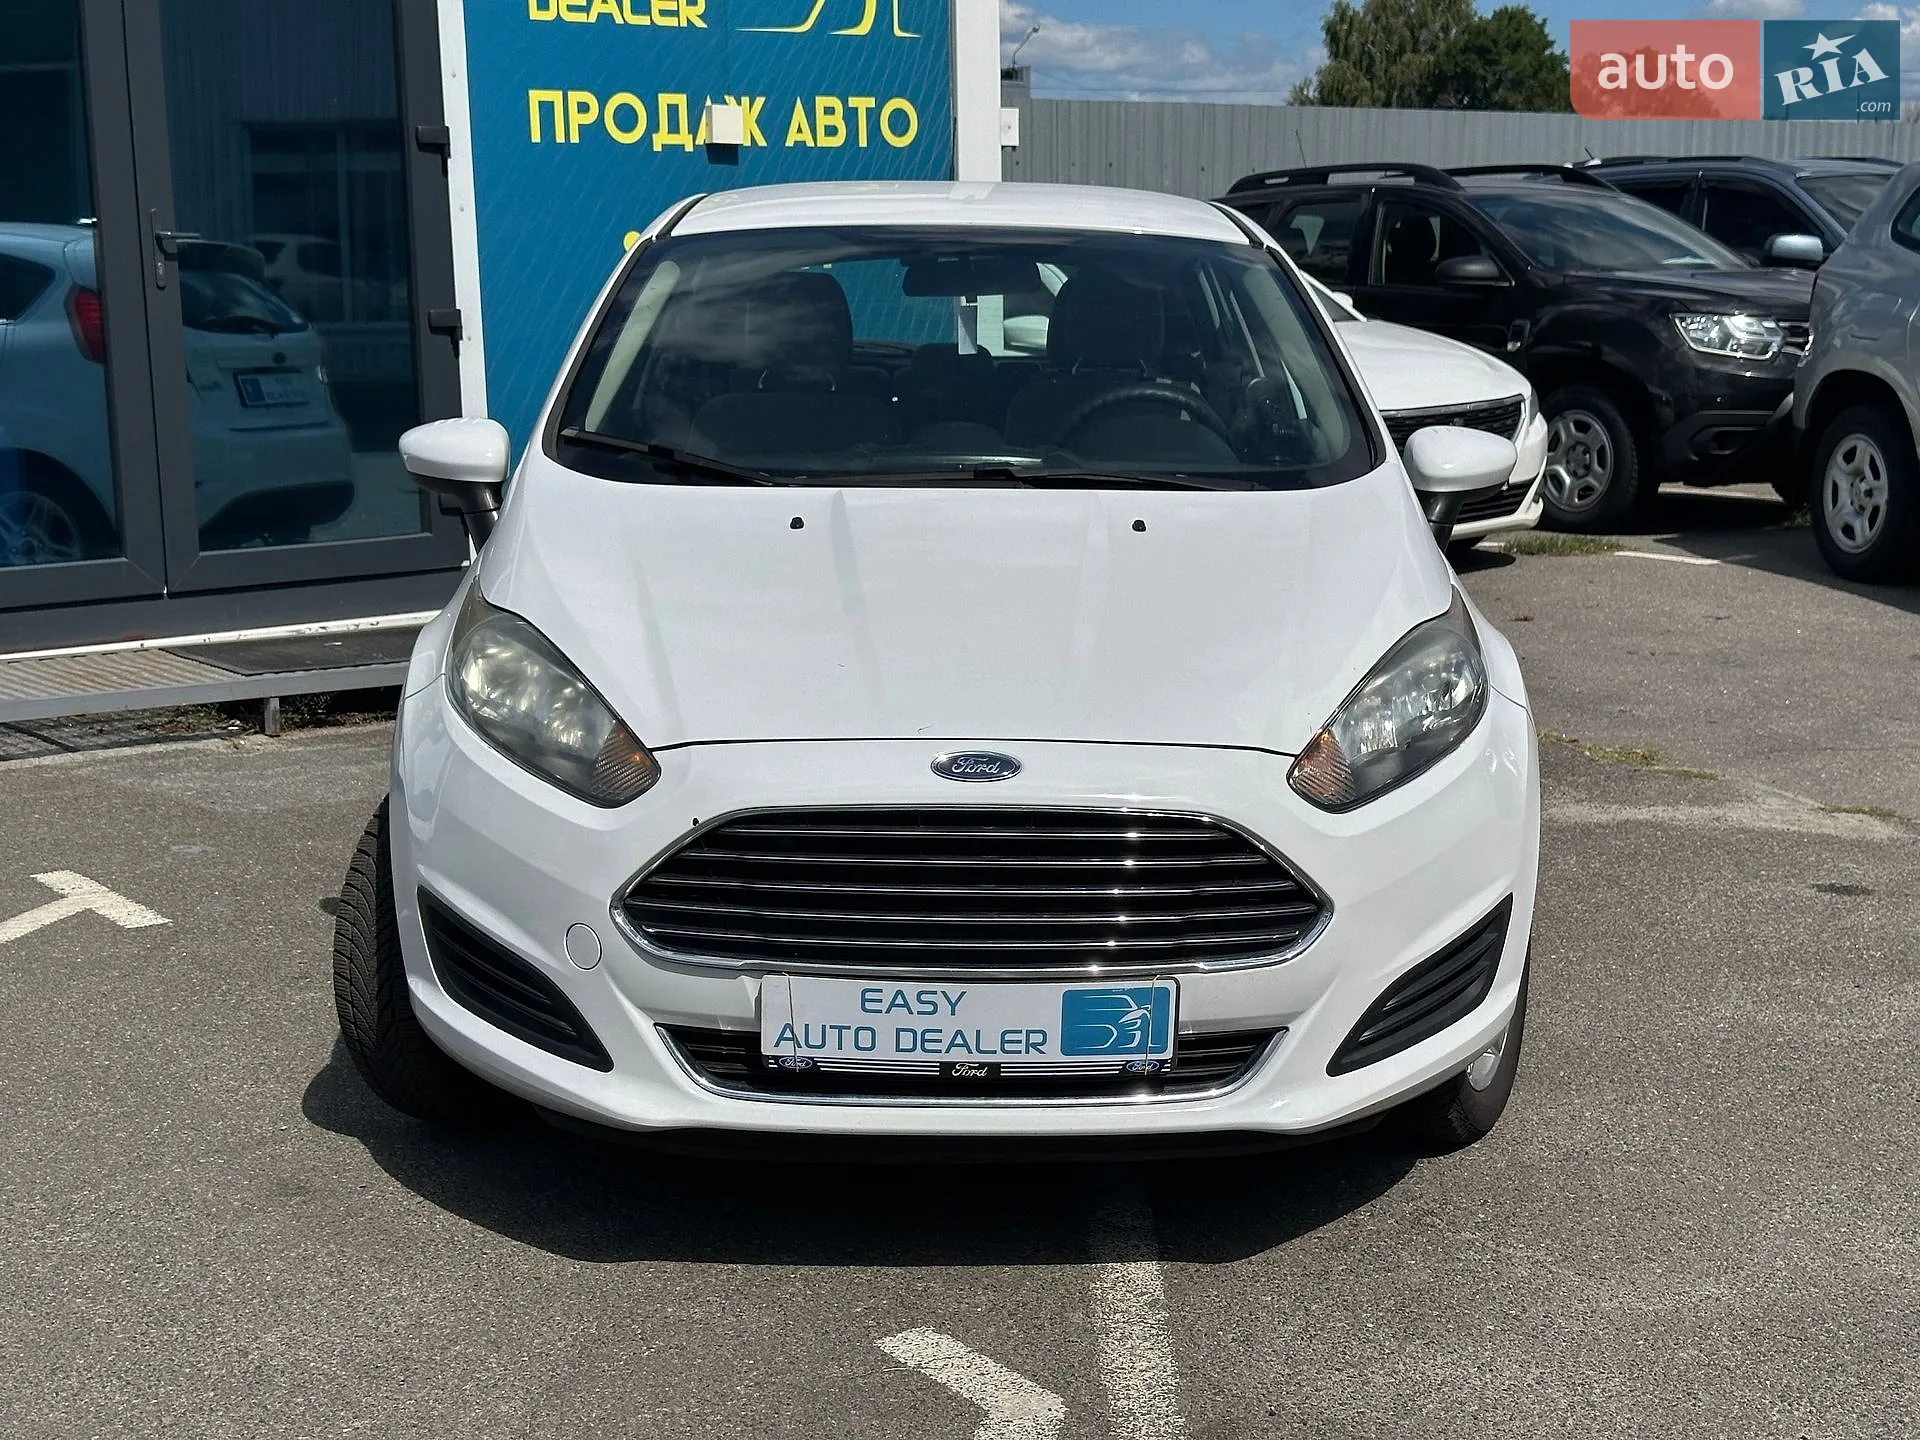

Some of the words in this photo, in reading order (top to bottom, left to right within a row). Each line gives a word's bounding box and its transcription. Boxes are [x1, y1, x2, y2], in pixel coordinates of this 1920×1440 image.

[785, 95, 919, 148] АВТО
[952, 756, 1001, 774] Ford
[860, 988, 967, 1016] EASY
[774, 1023, 877, 1052] AUTO
[895, 1026, 1048, 1055] DEALER
[951, 1062, 989, 1077] Ford
